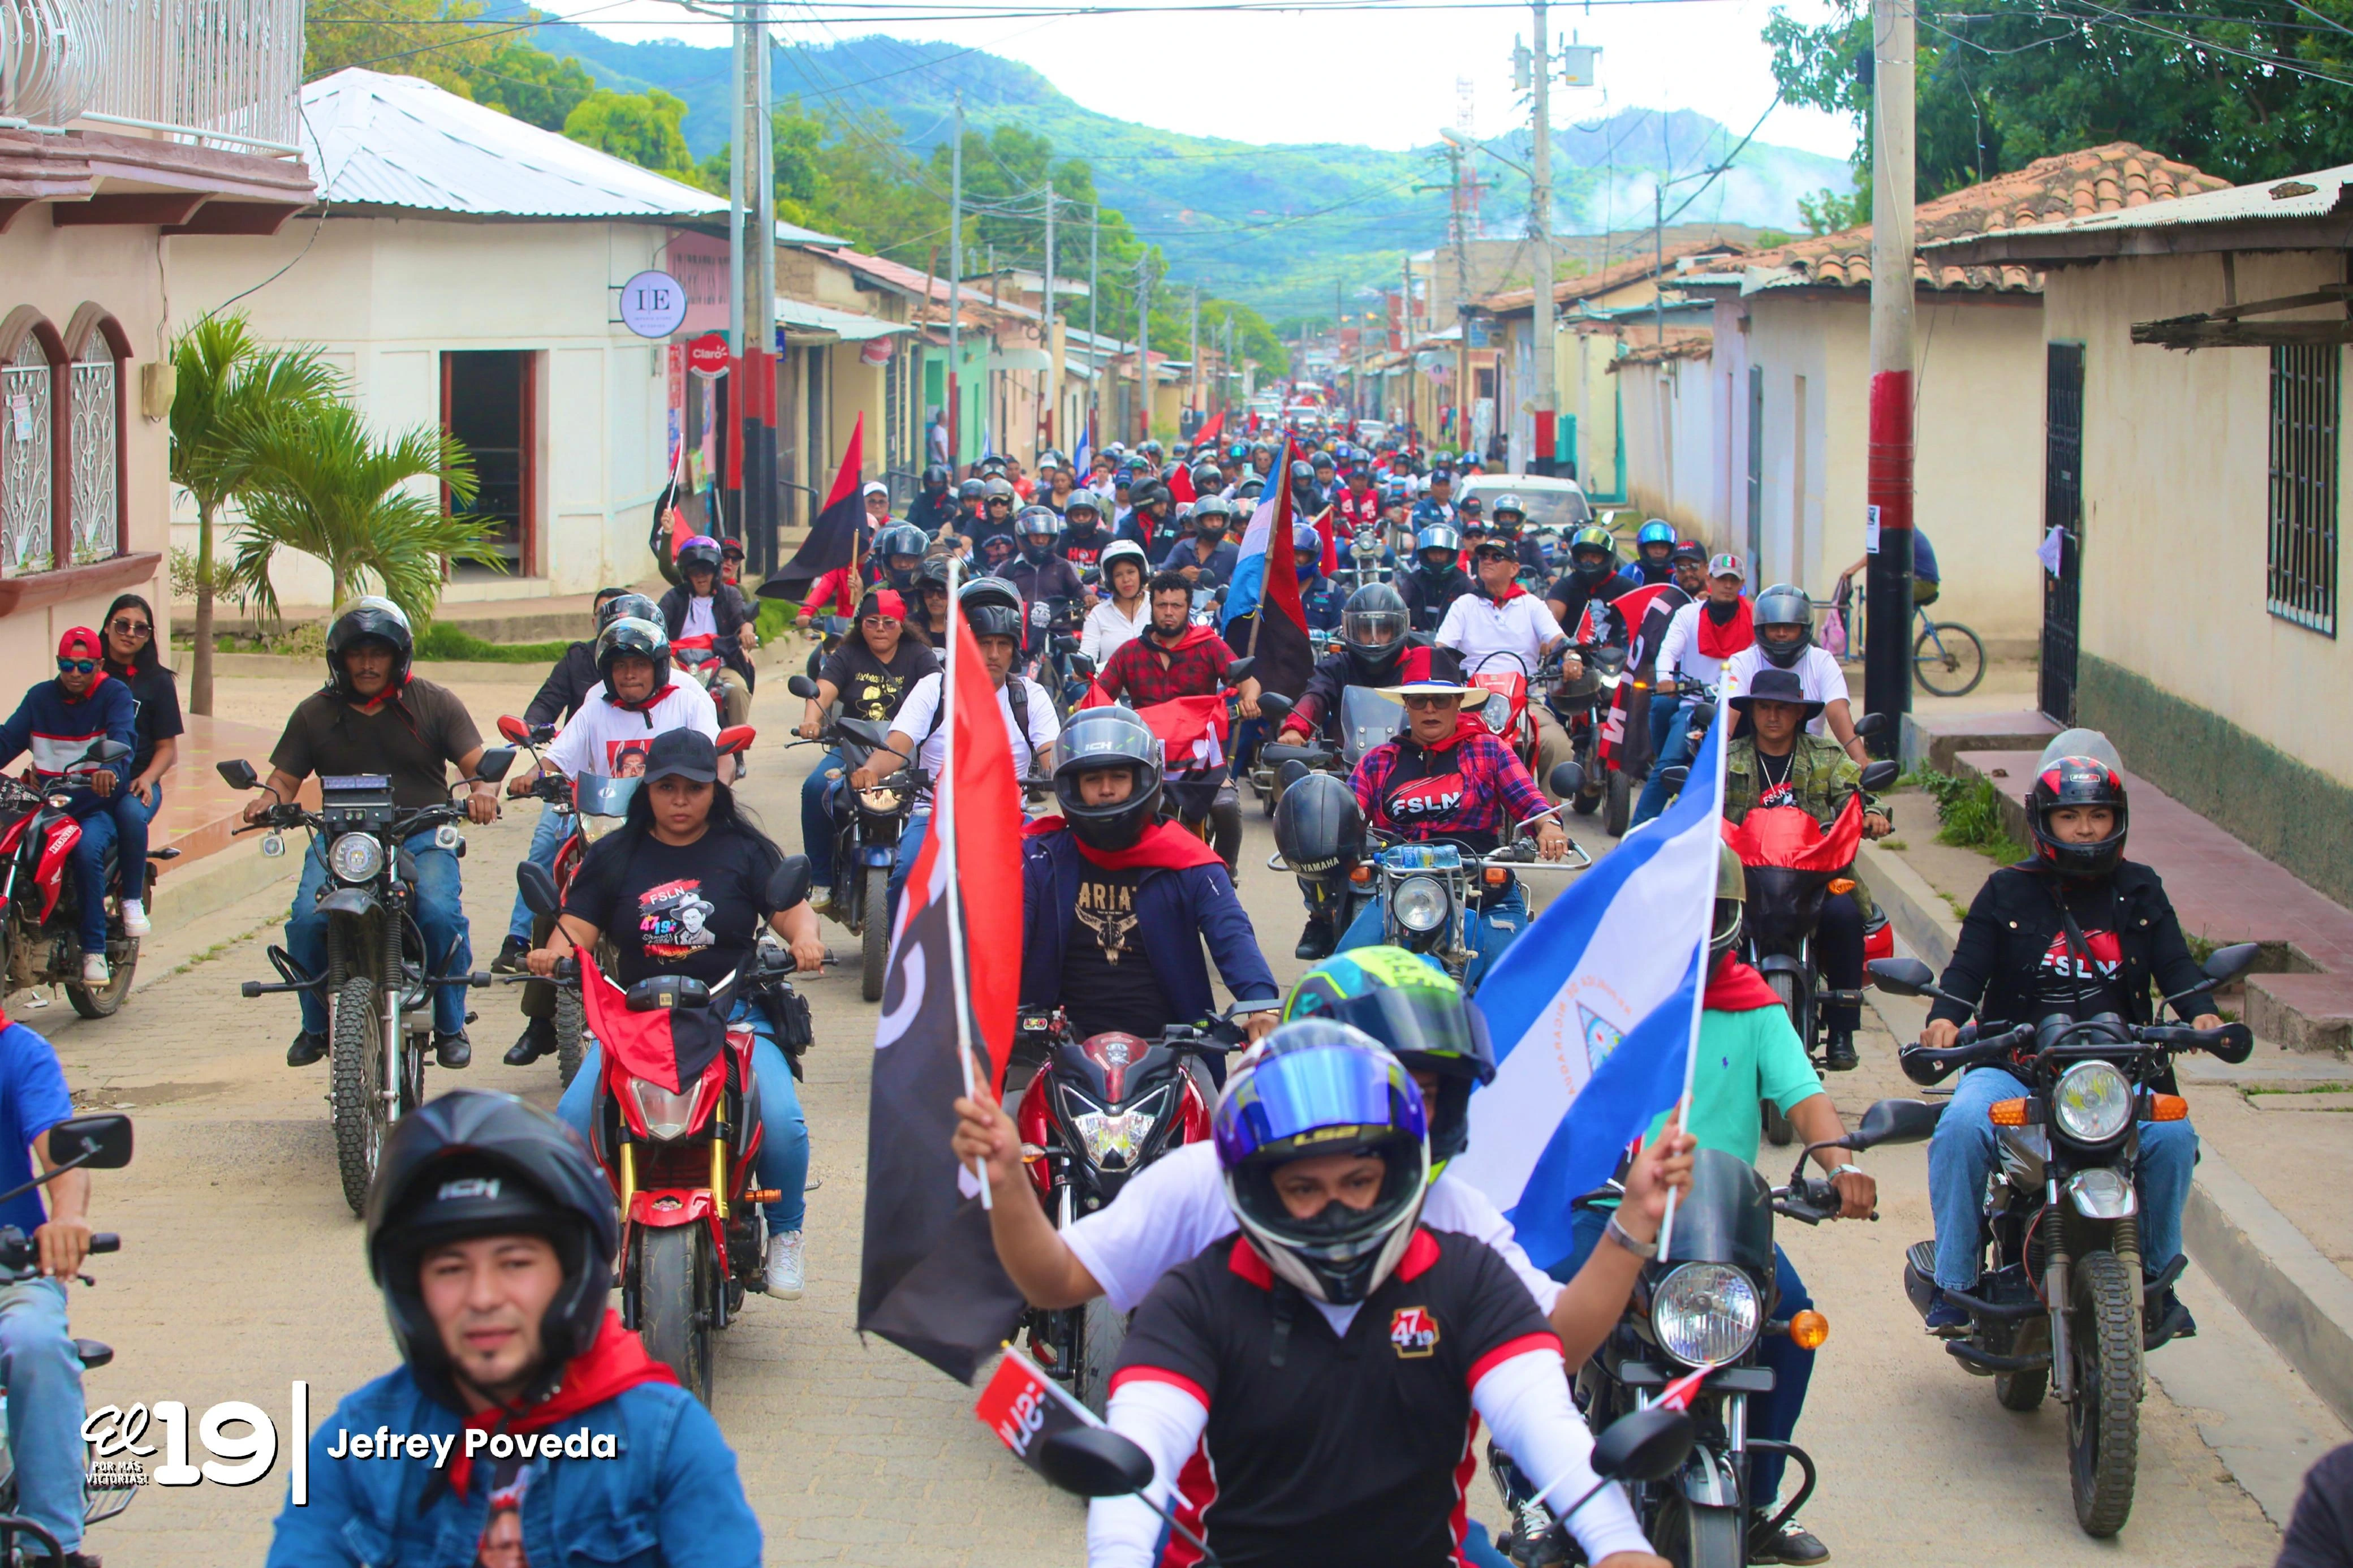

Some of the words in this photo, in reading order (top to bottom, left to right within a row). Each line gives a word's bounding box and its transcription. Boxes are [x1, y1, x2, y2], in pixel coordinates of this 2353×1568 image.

[692, 348, 722, 359] Claro
[1392, 792, 1462, 816] FSLN
[49, 825, 79, 854] HONDA
[1301, 856, 1340, 873] YAMAHA
[650, 886, 686, 905] FSLN
